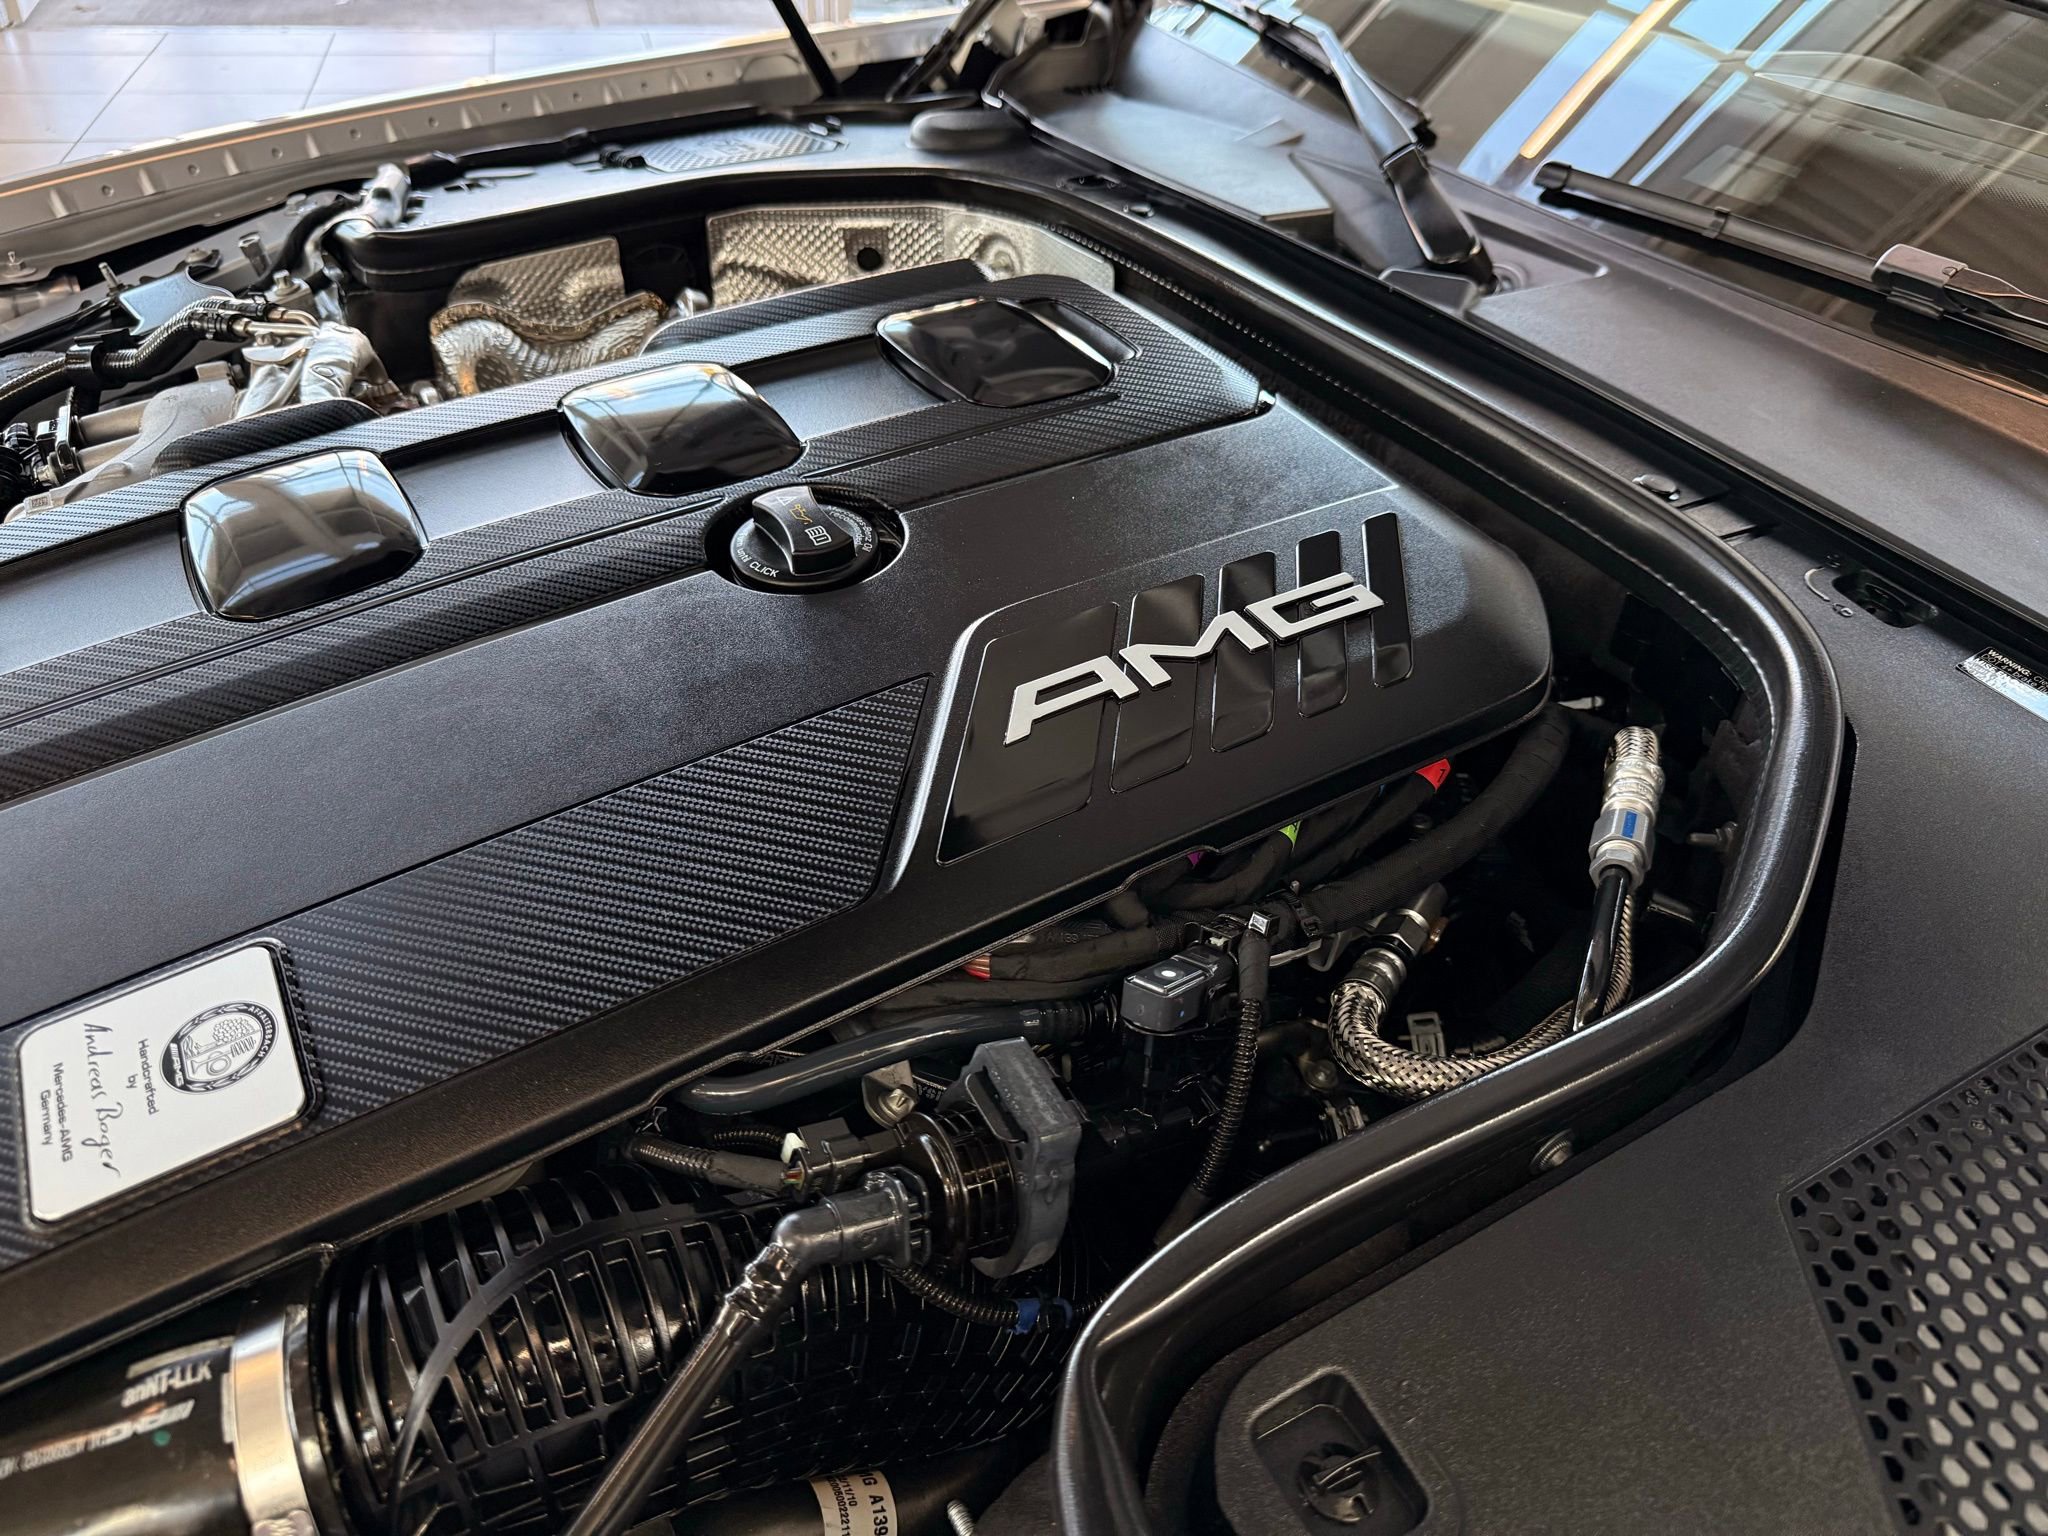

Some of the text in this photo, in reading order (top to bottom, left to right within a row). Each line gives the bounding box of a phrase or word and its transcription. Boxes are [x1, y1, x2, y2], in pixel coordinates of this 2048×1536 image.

[749, 561, 780, 578] CLICK
[1003, 570, 1385, 747] AMG
[1988, 649, 2032, 677] WARNING:
[2011, 671, 2038, 687] brake
[247, 1005, 274, 1058] AFFALTERBACH
[83, 1022, 114, 1100] Andreas
[126, 1073, 139, 1090] by
[138, 1038, 160, 1116] Handcrafted
[172, 1056, 185, 1088] AMG
[40, 1088, 54, 1146] Germany
[53, 1061, 74, 1163] Mercedes-AMG
